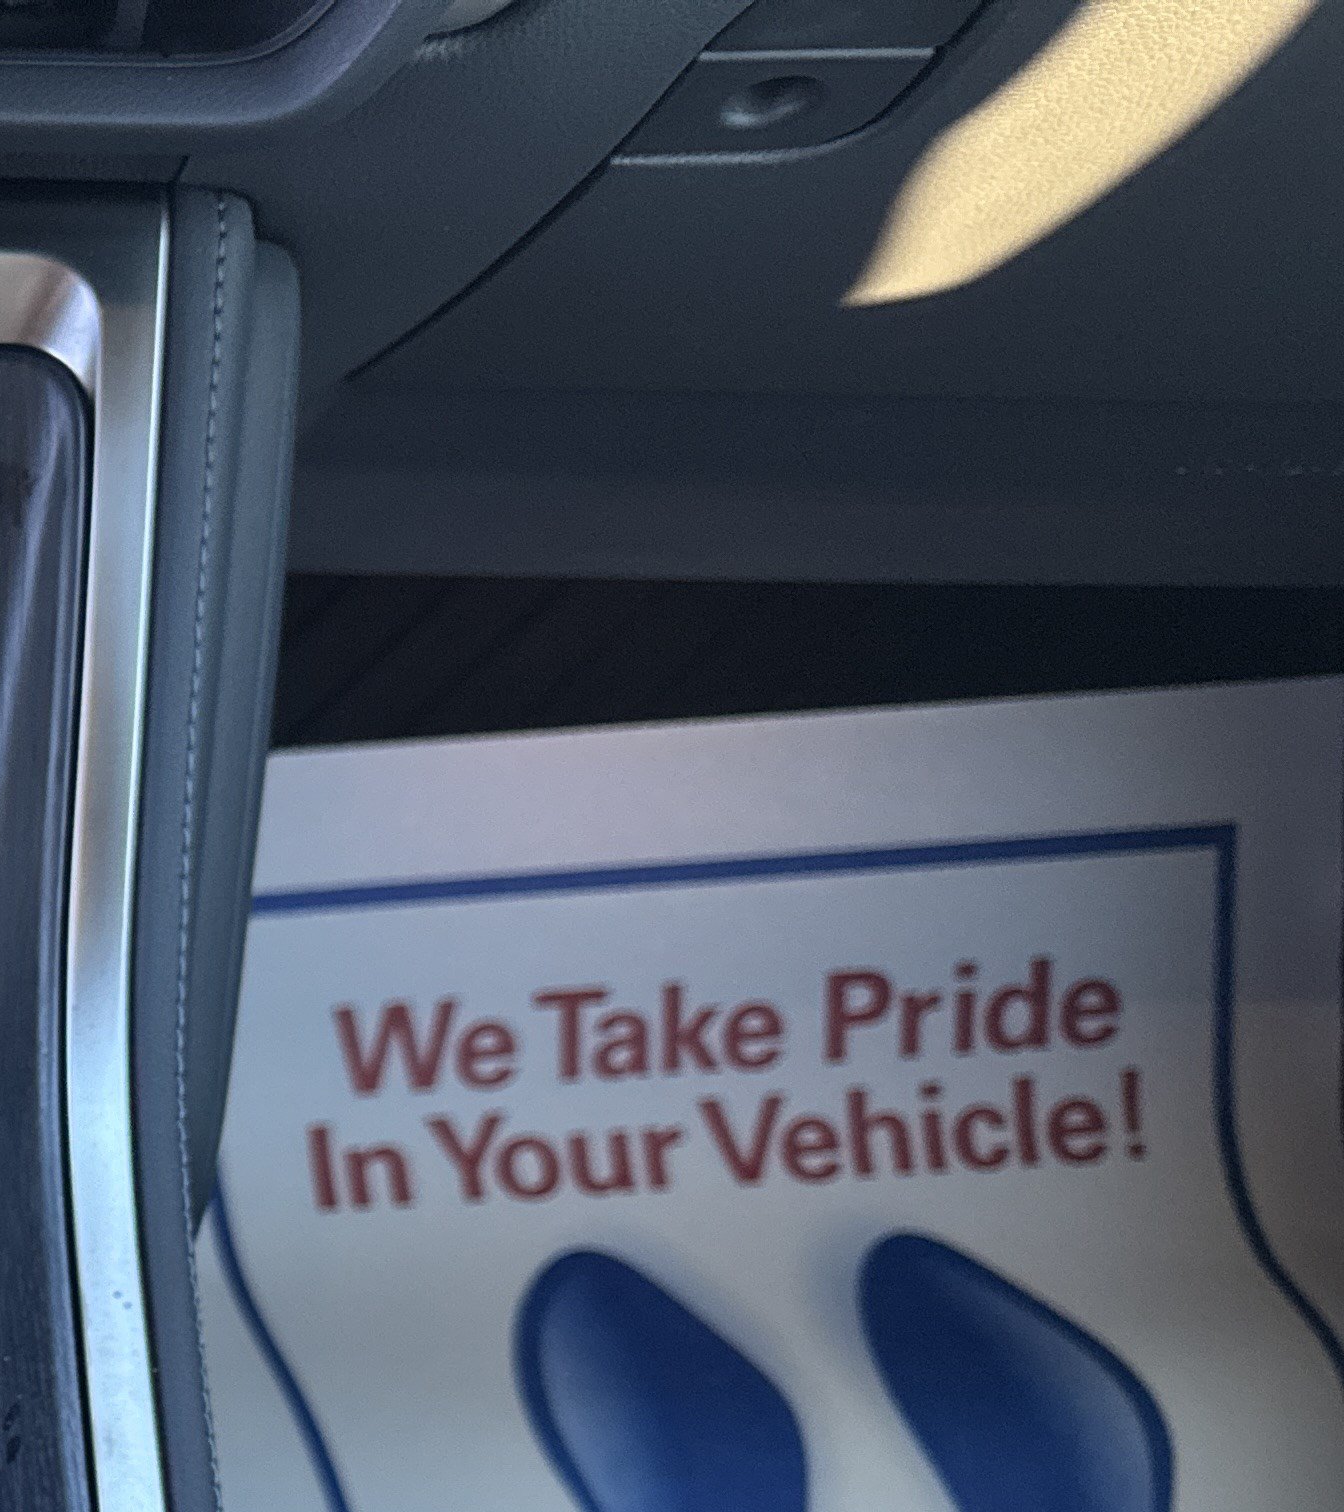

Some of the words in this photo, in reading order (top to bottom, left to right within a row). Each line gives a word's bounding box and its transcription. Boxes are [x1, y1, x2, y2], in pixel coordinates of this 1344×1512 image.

[337, 1001, 516, 1094] We
[534, 985, 783, 1078] Take
[824, 956, 1121, 1061] Pride
[310, 1126, 411, 1208] In
[434, 1116, 680, 1199] Your
[698, 1066, 1150, 1183] Vehicle!
